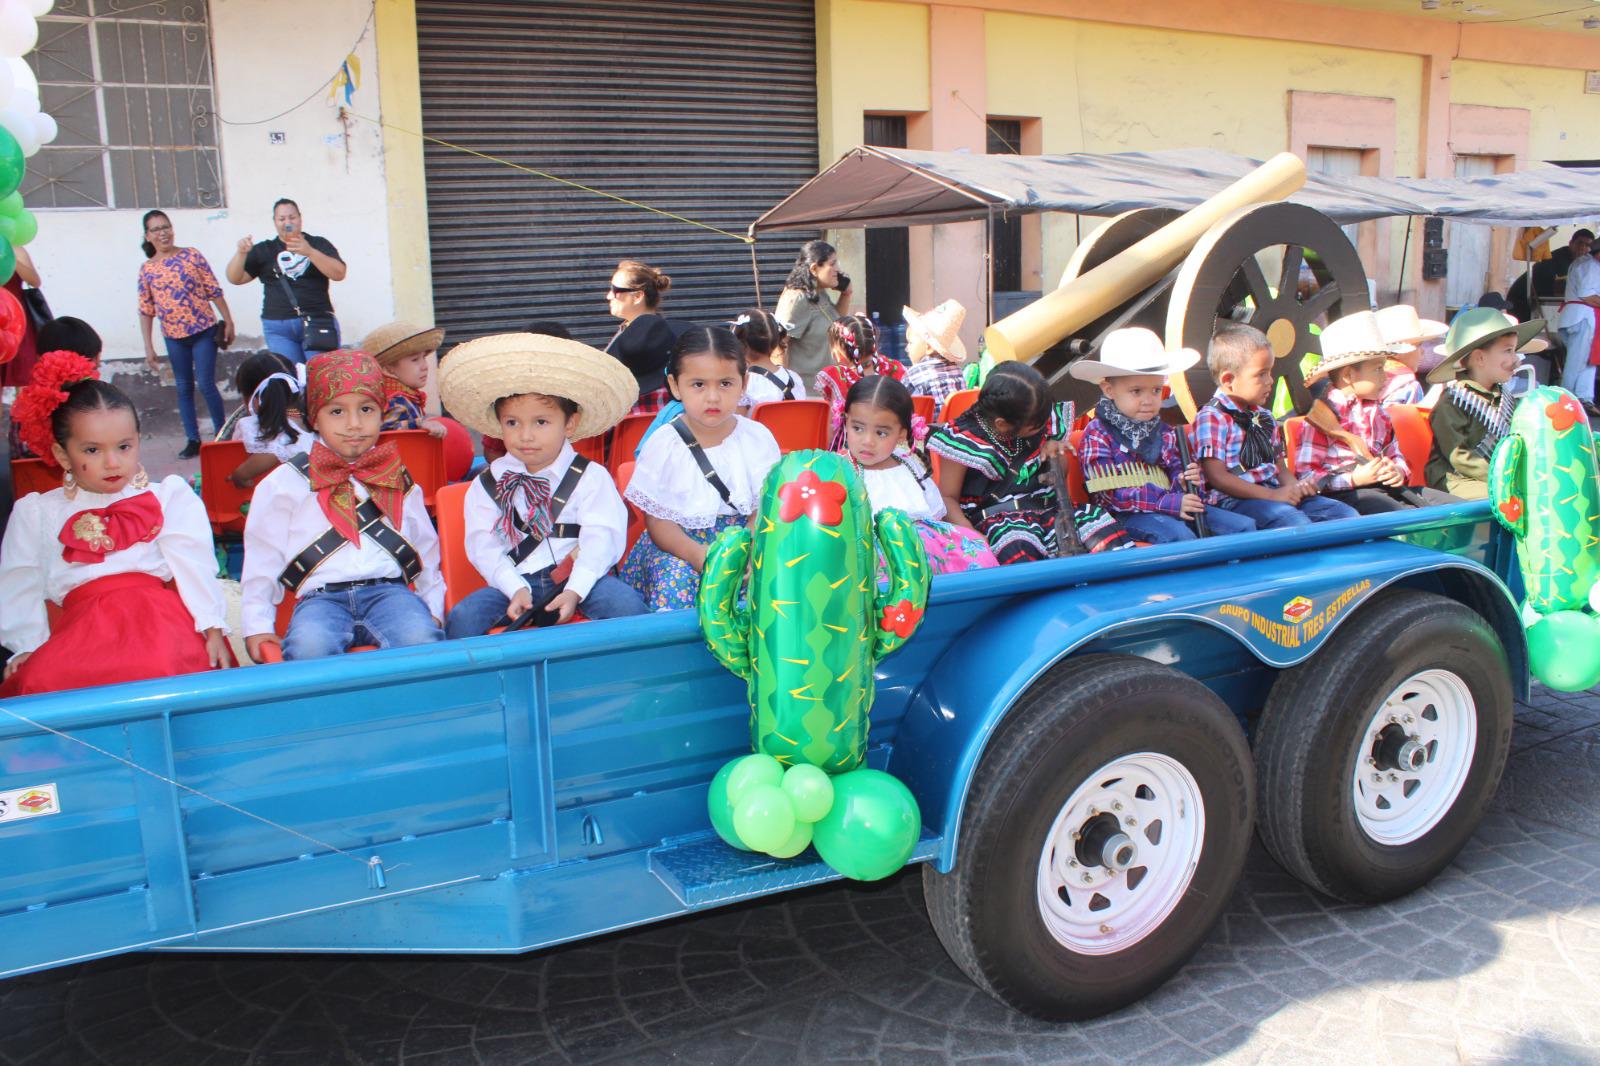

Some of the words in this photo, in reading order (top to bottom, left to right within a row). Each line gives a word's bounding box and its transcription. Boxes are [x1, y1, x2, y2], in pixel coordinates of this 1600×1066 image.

[1219, 604, 1250, 623] GRUPO
[1251, 612, 1301, 648] INDUSTRIAL
[1303, 612, 1325, 644] TRES
[1326, 579, 1371, 623] ESTRELLAS
